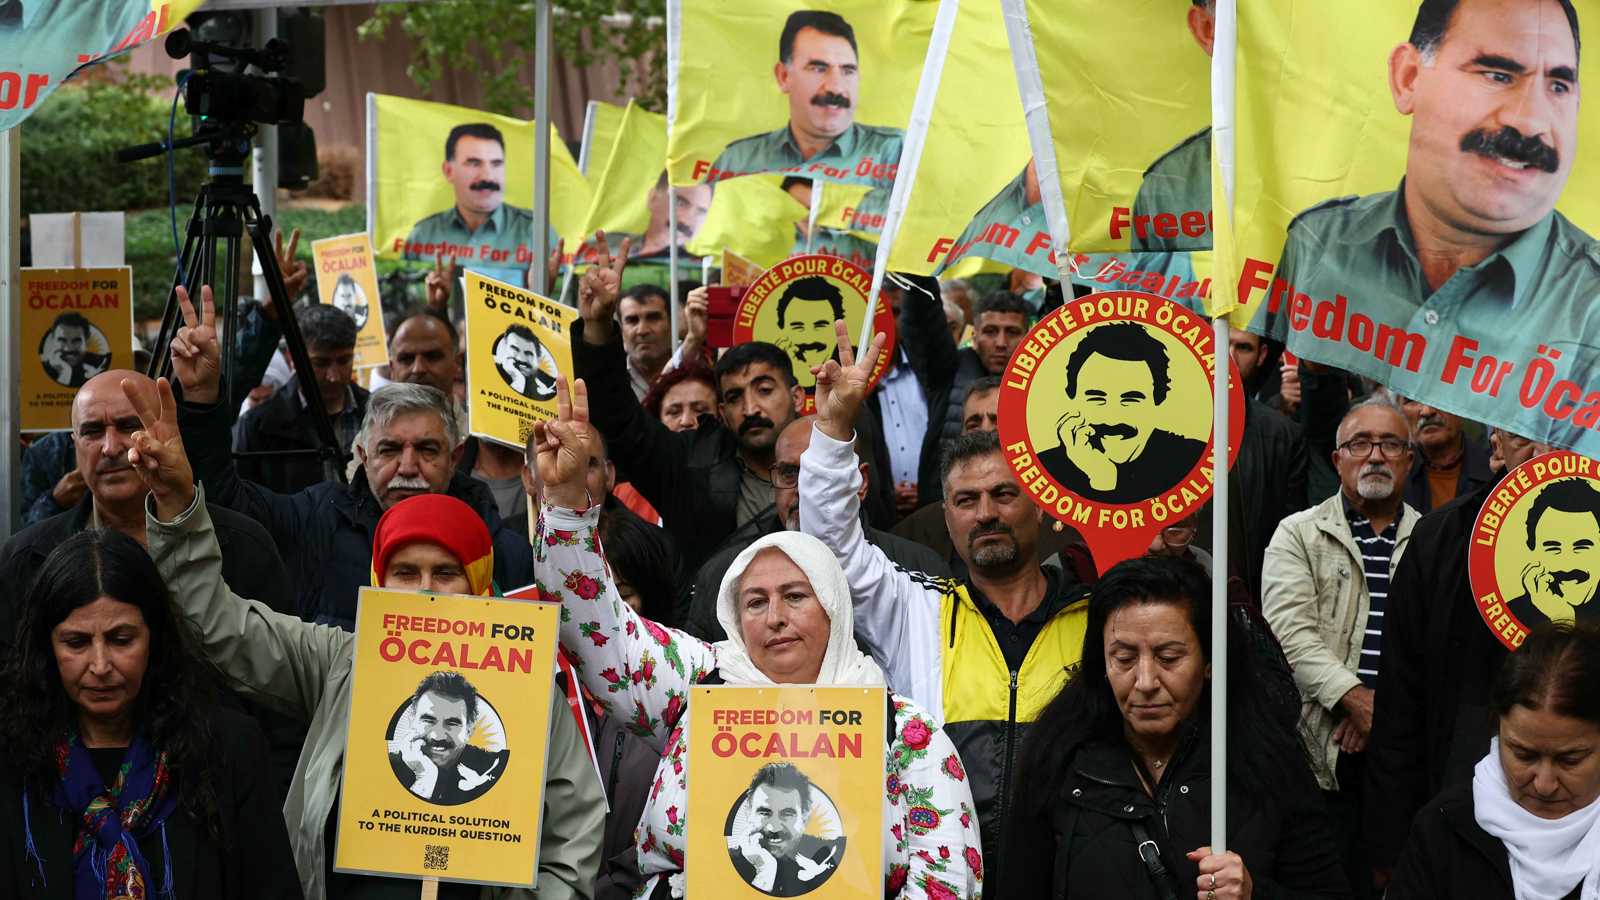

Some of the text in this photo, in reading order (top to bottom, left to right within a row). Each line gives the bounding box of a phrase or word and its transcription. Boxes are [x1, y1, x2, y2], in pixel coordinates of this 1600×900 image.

[1109, 207, 1213, 240] Free
[480, 244, 510, 262] For
[28, 280, 118, 290] FREEDOM FOR
[29, 290, 119, 309] ÖCALAN
[479, 281, 562, 318] FREEDOM FOR
[739, 267, 781, 328] LIBERTÉ
[781, 259, 827, 279] POUR
[484, 293, 562, 334] ÖCALAN
[1007, 306, 1078, 391] LIBERTÉ
[1080, 297, 1149, 322] POUR
[488, 391, 528, 408] POLITICAL
[1440, 335, 1514, 398] For
[1519, 344, 1600, 432] Öca
[487, 401, 536, 421] THE KURDISH
[1007, 440, 1093, 525] FREEDOM
[1098, 509, 1145, 529] FOR
[1477, 455, 1591, 547] LIBERTÉ POUR
[383, 614, 535, 641] FREEDOM FOR
[1480, 592, 1527, 648] FREED
[379, 631, 533, 674] ÖCALAN
[713, 709, 862, 725] FREEDOM FOR
[711, 726, 862, 758] ÖCALAN
[358, 821, 521, 843] TO THE KURDISH QUESTION
[372, 809, 510, 829] A POLITICAL SOLUTION
